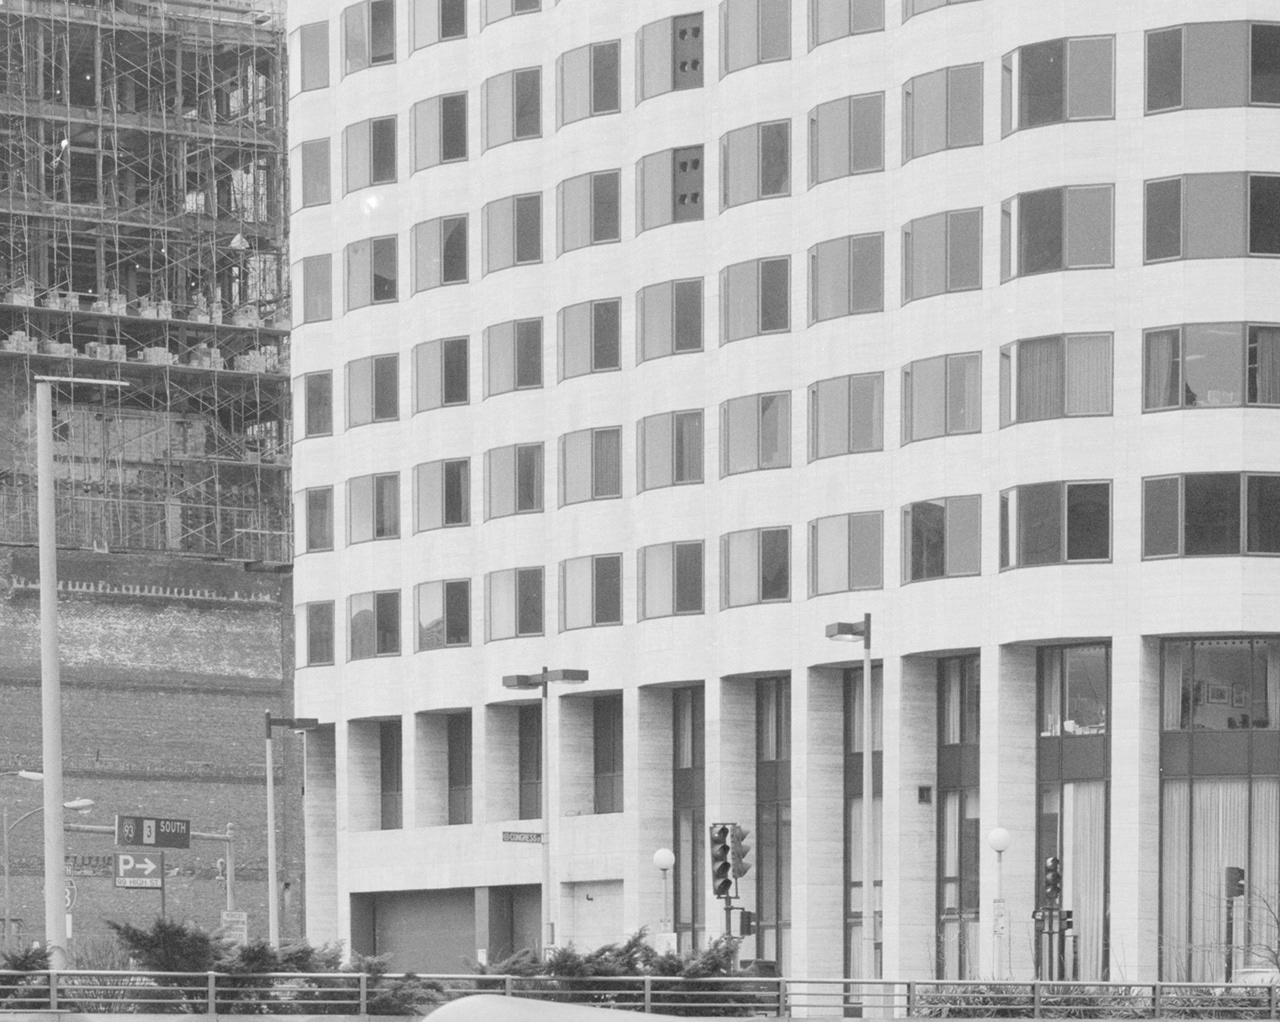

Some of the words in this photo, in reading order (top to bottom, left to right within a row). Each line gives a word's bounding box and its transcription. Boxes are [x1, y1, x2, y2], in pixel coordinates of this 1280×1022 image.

[124, 825, 134, 838] 93
[146, 825, 152, 838] 3
[160, 821, 187, 834] SOUTH
